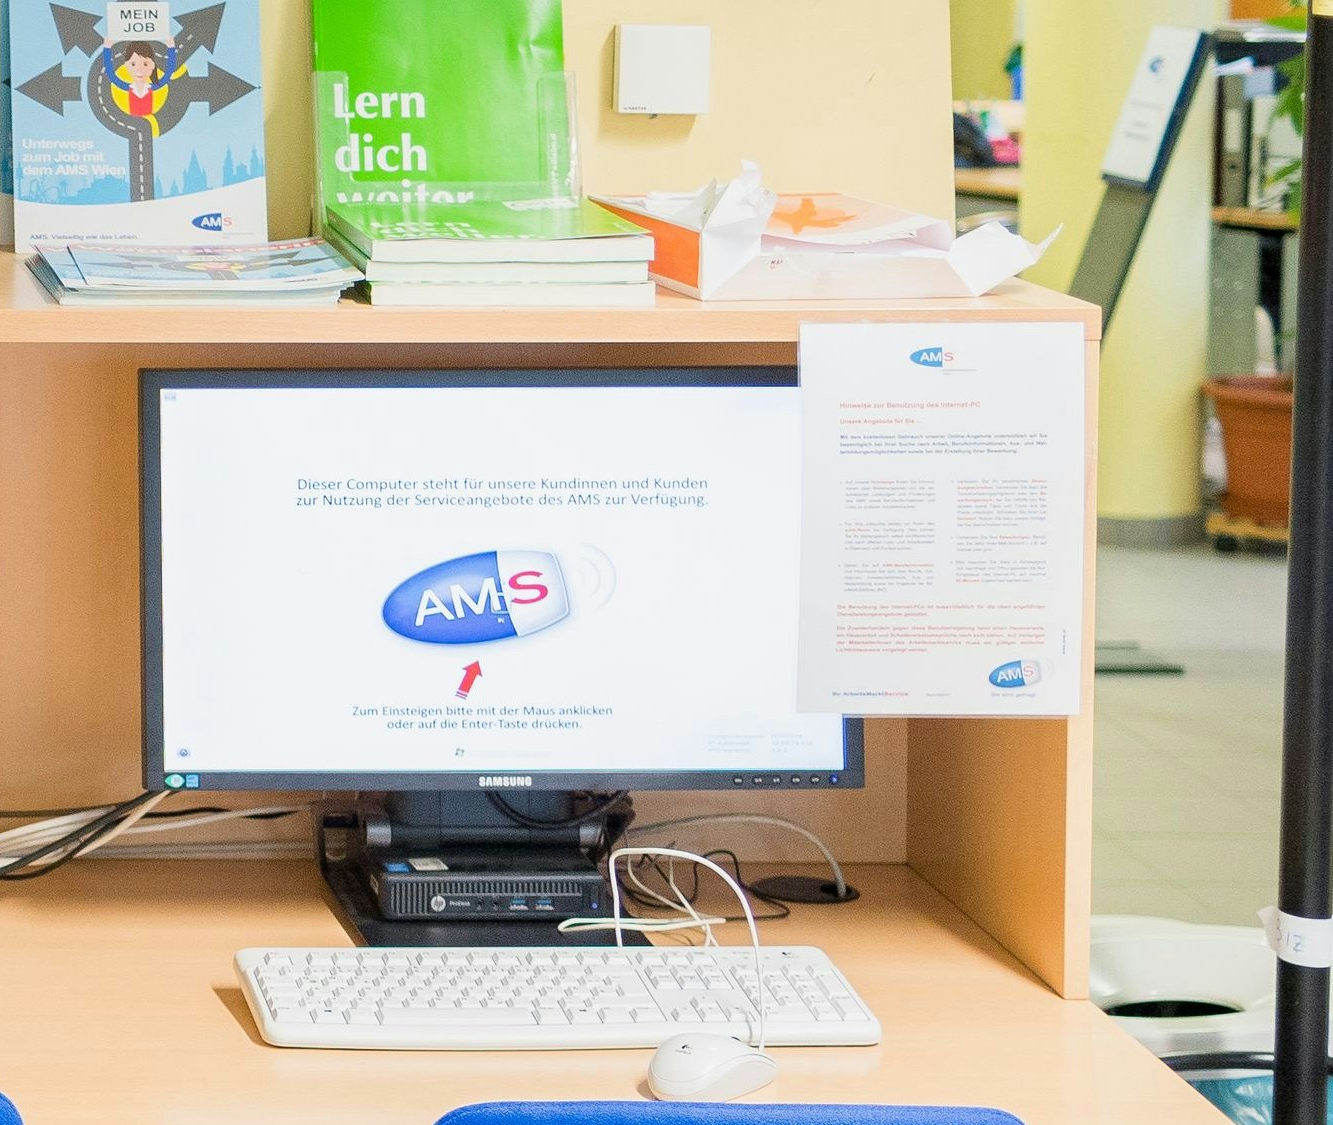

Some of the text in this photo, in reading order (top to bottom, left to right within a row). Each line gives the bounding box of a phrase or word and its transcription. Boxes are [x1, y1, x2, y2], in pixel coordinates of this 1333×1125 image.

[120, 9, 158, 20] MEIN
[123, 22, 155, 33] JOB
[333, 83, 426, 119] Lern
[21, 138, 94, 151] Unterwegs
[21, 151, 104, 163] zum Job mit
[334, 132, 428, 172] dich
[22, 164, 126, 176] dem AMS Wien
[200, 216, 233, 227] AMS
[919, 352, 954, 363] AMS
[297, 478, 709, 493] Dieser Computer steht für unsere Kundinnen und Kunden
[296, 493, 710, 509] zur Nutzung der Serviceangebote des AMS zur Verfügung.
[414, 571, 549, 626] AMS
[997, 665, 1034, 683] AMS
[352, 706, 612, 719] Zum Einsteigen bitte mit der Maus anklicken
[387, 719, 582, 729] oder auf die Enter-Taste drücken.
[478, 776, 532, 787] SAMSUNG
